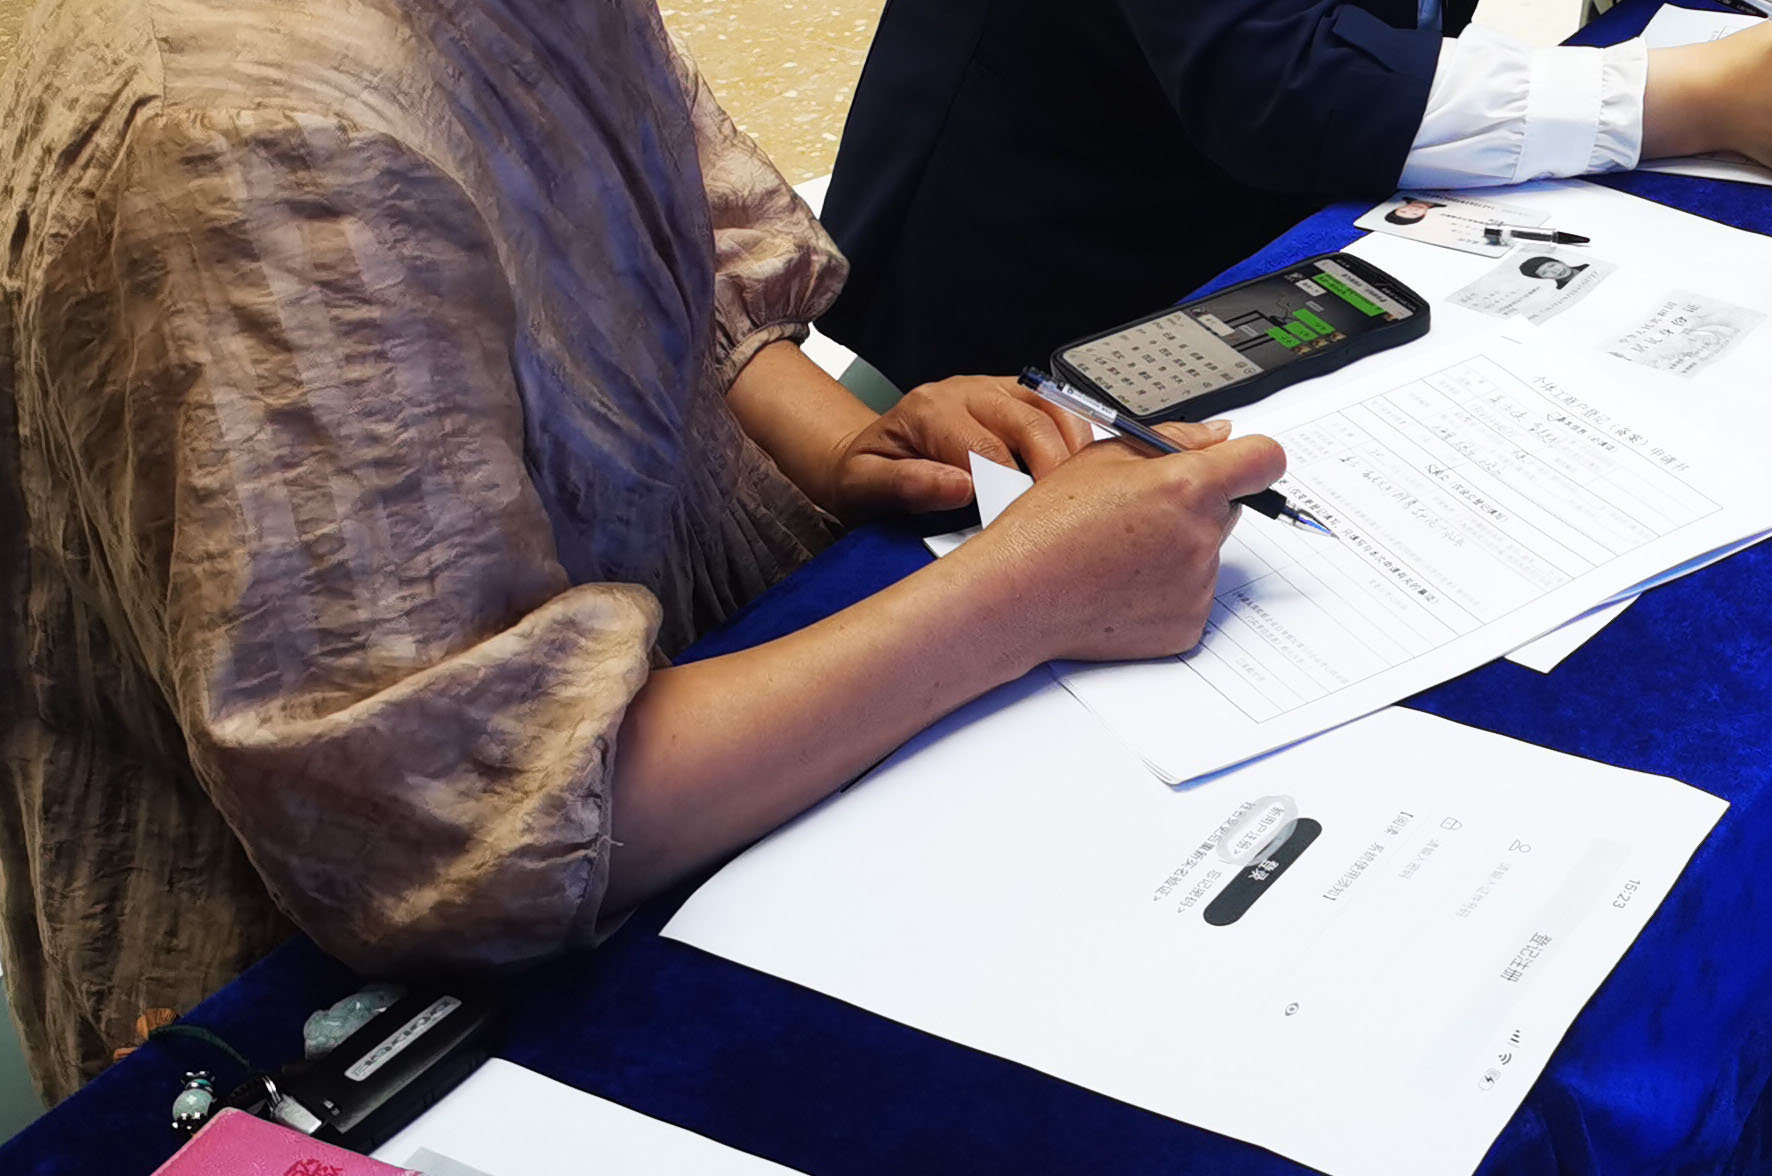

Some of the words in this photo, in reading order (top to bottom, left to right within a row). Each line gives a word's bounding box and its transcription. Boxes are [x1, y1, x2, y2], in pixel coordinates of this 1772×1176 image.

[1248, 857, 1279, 883] 登录
[1612, 878, 1641, 910] 15:23
[1500, 931, 1552, 984] 登记注册
